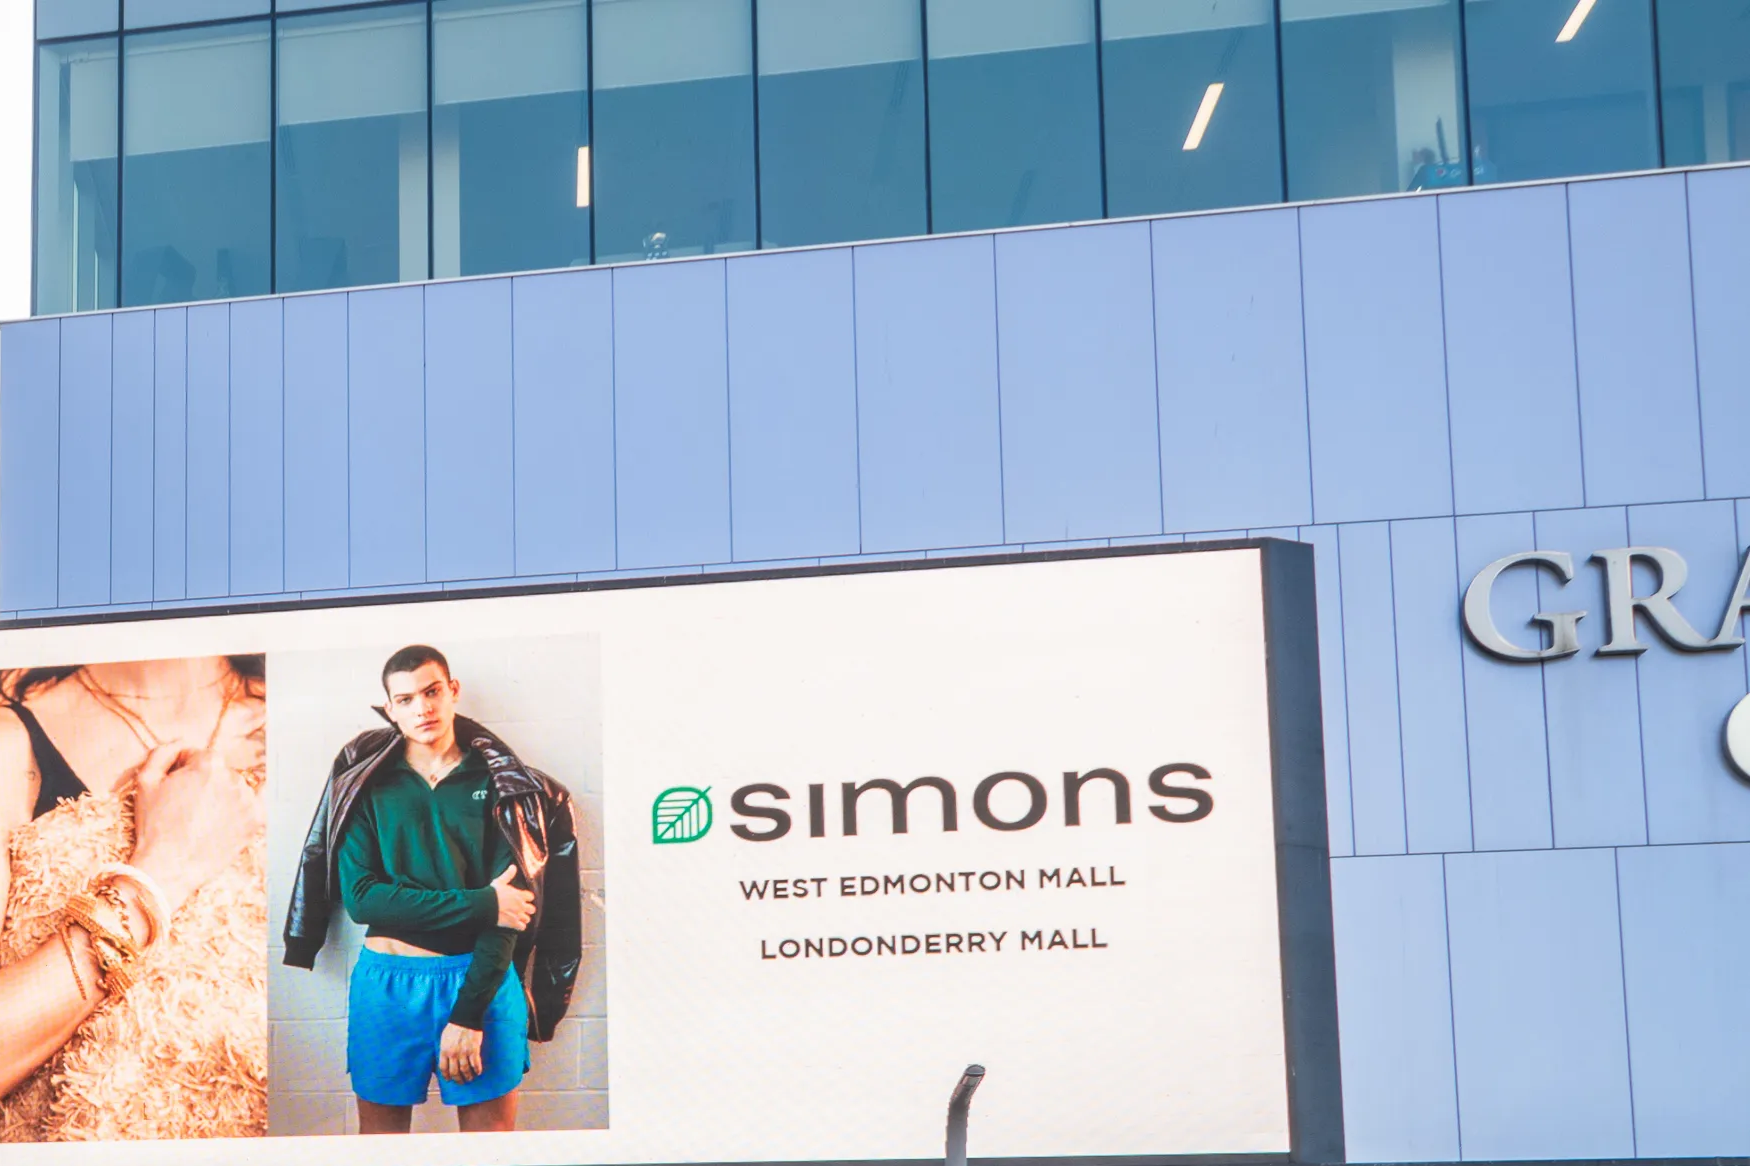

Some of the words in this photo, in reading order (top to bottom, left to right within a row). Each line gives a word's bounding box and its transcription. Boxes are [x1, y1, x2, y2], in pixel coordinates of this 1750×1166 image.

[729, 762, 1215, 842] simons
[739, 877, 828, 900] WEST
[840, 869, 1026, 897] EDMONTON
[1039, 866, 1127, 889] MALL
[761, 931, 1008, 960] LONDONDERRY
[1021, 928, 1109, 951] MALL
